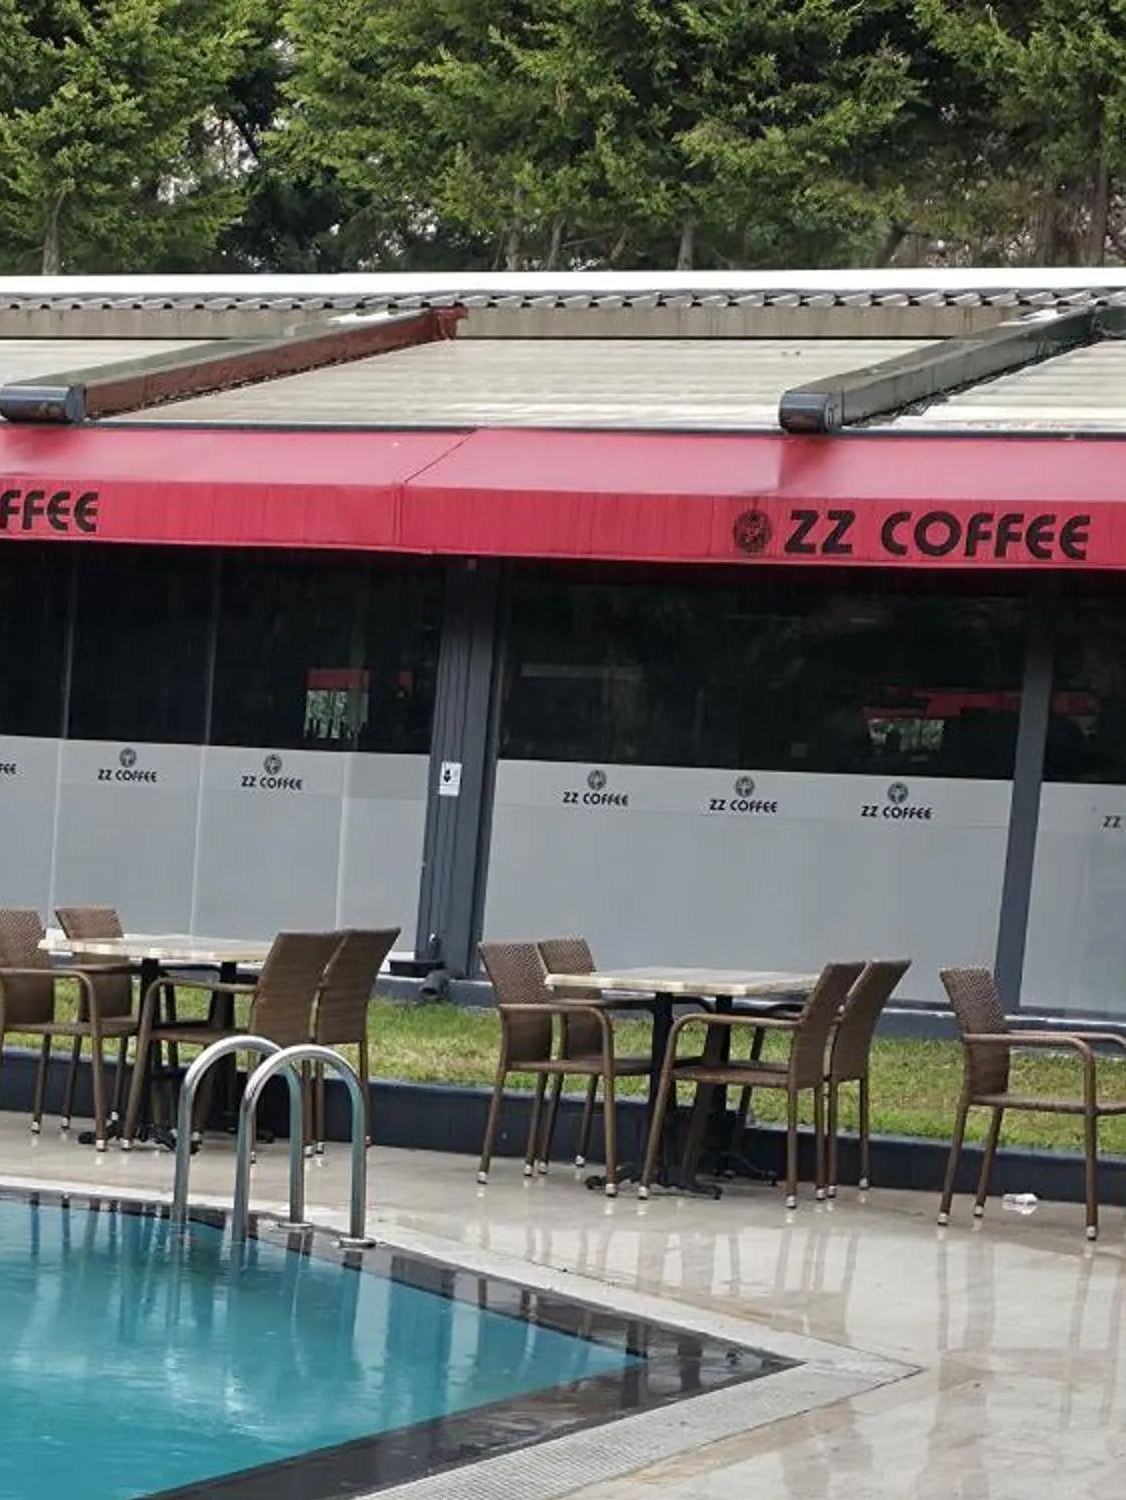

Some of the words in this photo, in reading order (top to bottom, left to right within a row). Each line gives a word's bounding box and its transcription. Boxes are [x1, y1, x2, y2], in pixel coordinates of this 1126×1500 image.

[784, 510, 856, 554] ZZ
[880, 511, 1091, 560] COFFEE
[97, 769, 113, 781] ZZ
[115, 769, 157, 783] COFFEE
[241, 776, 257, 788] ZZ
[259, 776, 303, 791] COFFEE
[562, 792, 579, 805] ZZ
[582, 792, 629, 807] COFFEE
[709, 799, 727, 811] ZZ
[729, 799, 778, 814] COFFEE
[860, 806, 879, 818] ZZ
[882, 805, 932, 820] COFFEE
[1103, 815, 1122, 829] ZZ
